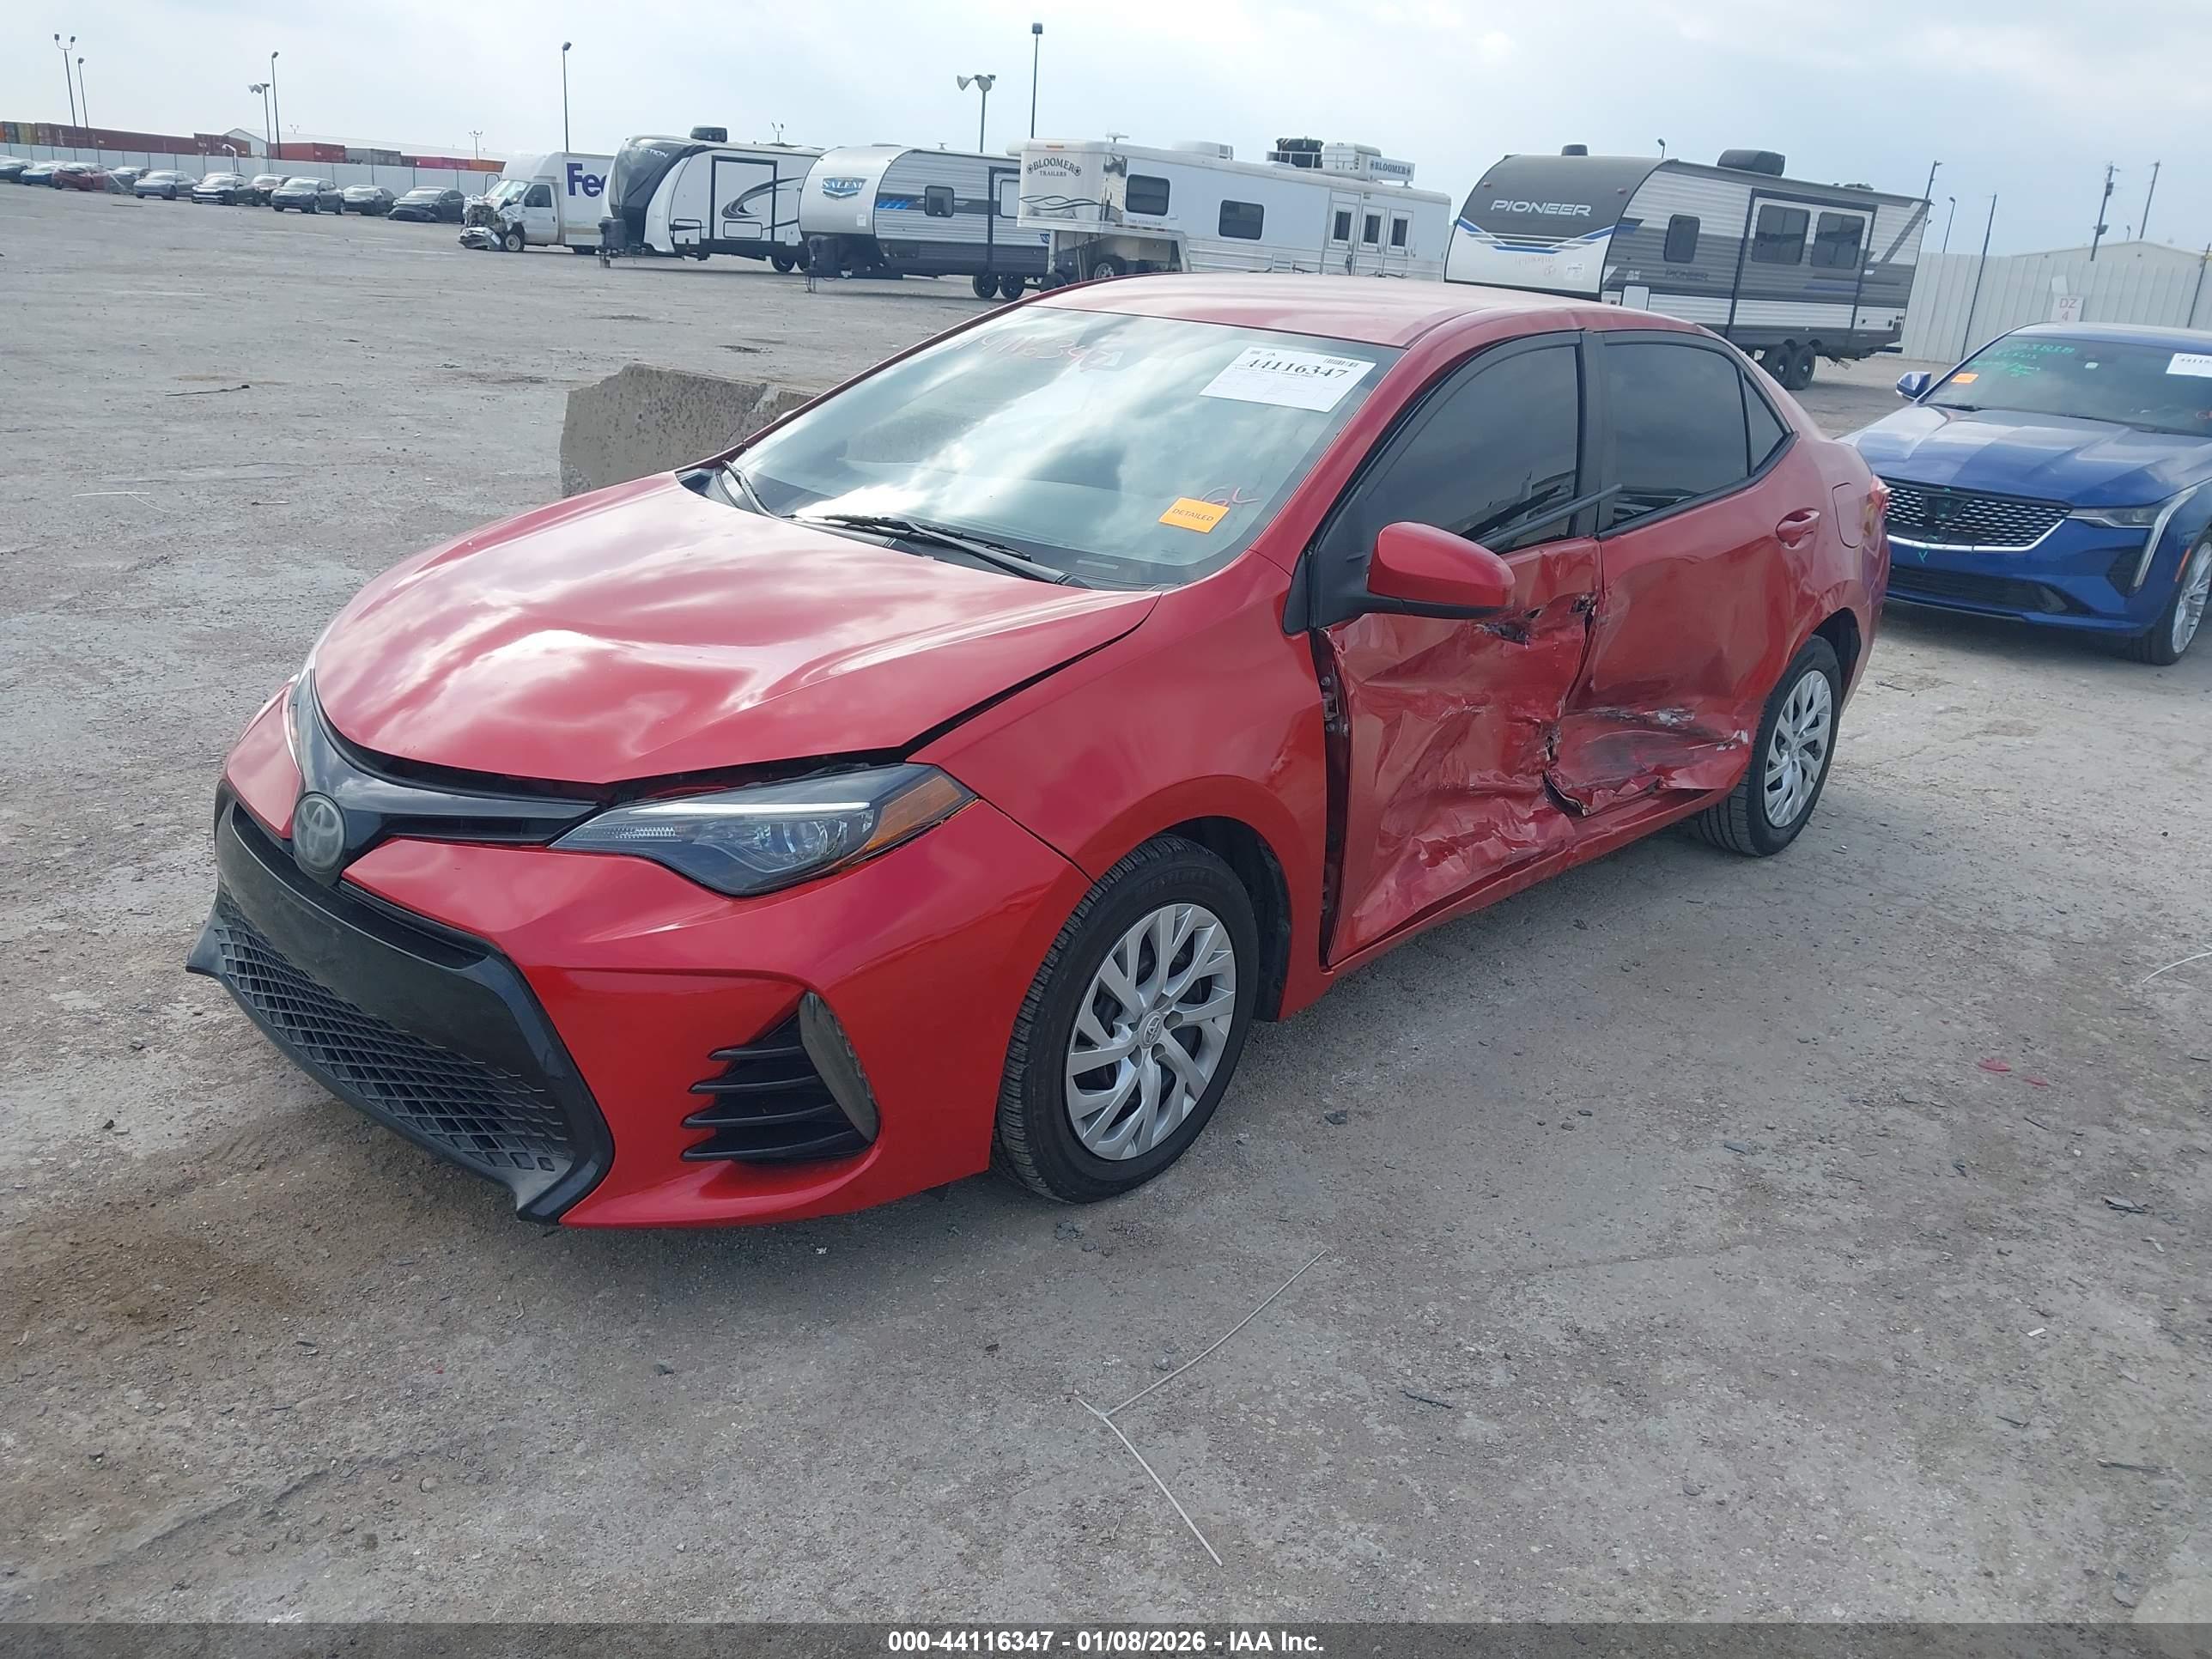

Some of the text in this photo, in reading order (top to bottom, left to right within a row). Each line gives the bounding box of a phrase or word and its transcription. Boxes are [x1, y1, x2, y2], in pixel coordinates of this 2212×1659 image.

[1033, 157, 1075, 173] BLOOMER
[1375, 161, 1407, 175] BLOOMER
[823, 179, 862, 189] SALEM
[1491, 199, 1591, 216] PIONEER
[2059, 297, 2078, 309] DZ
[2061, 311, 2069, 321] 4
[1248, 358, 1349, 379] 44116347
[1171, 507, 1214, 522] DETAILED
